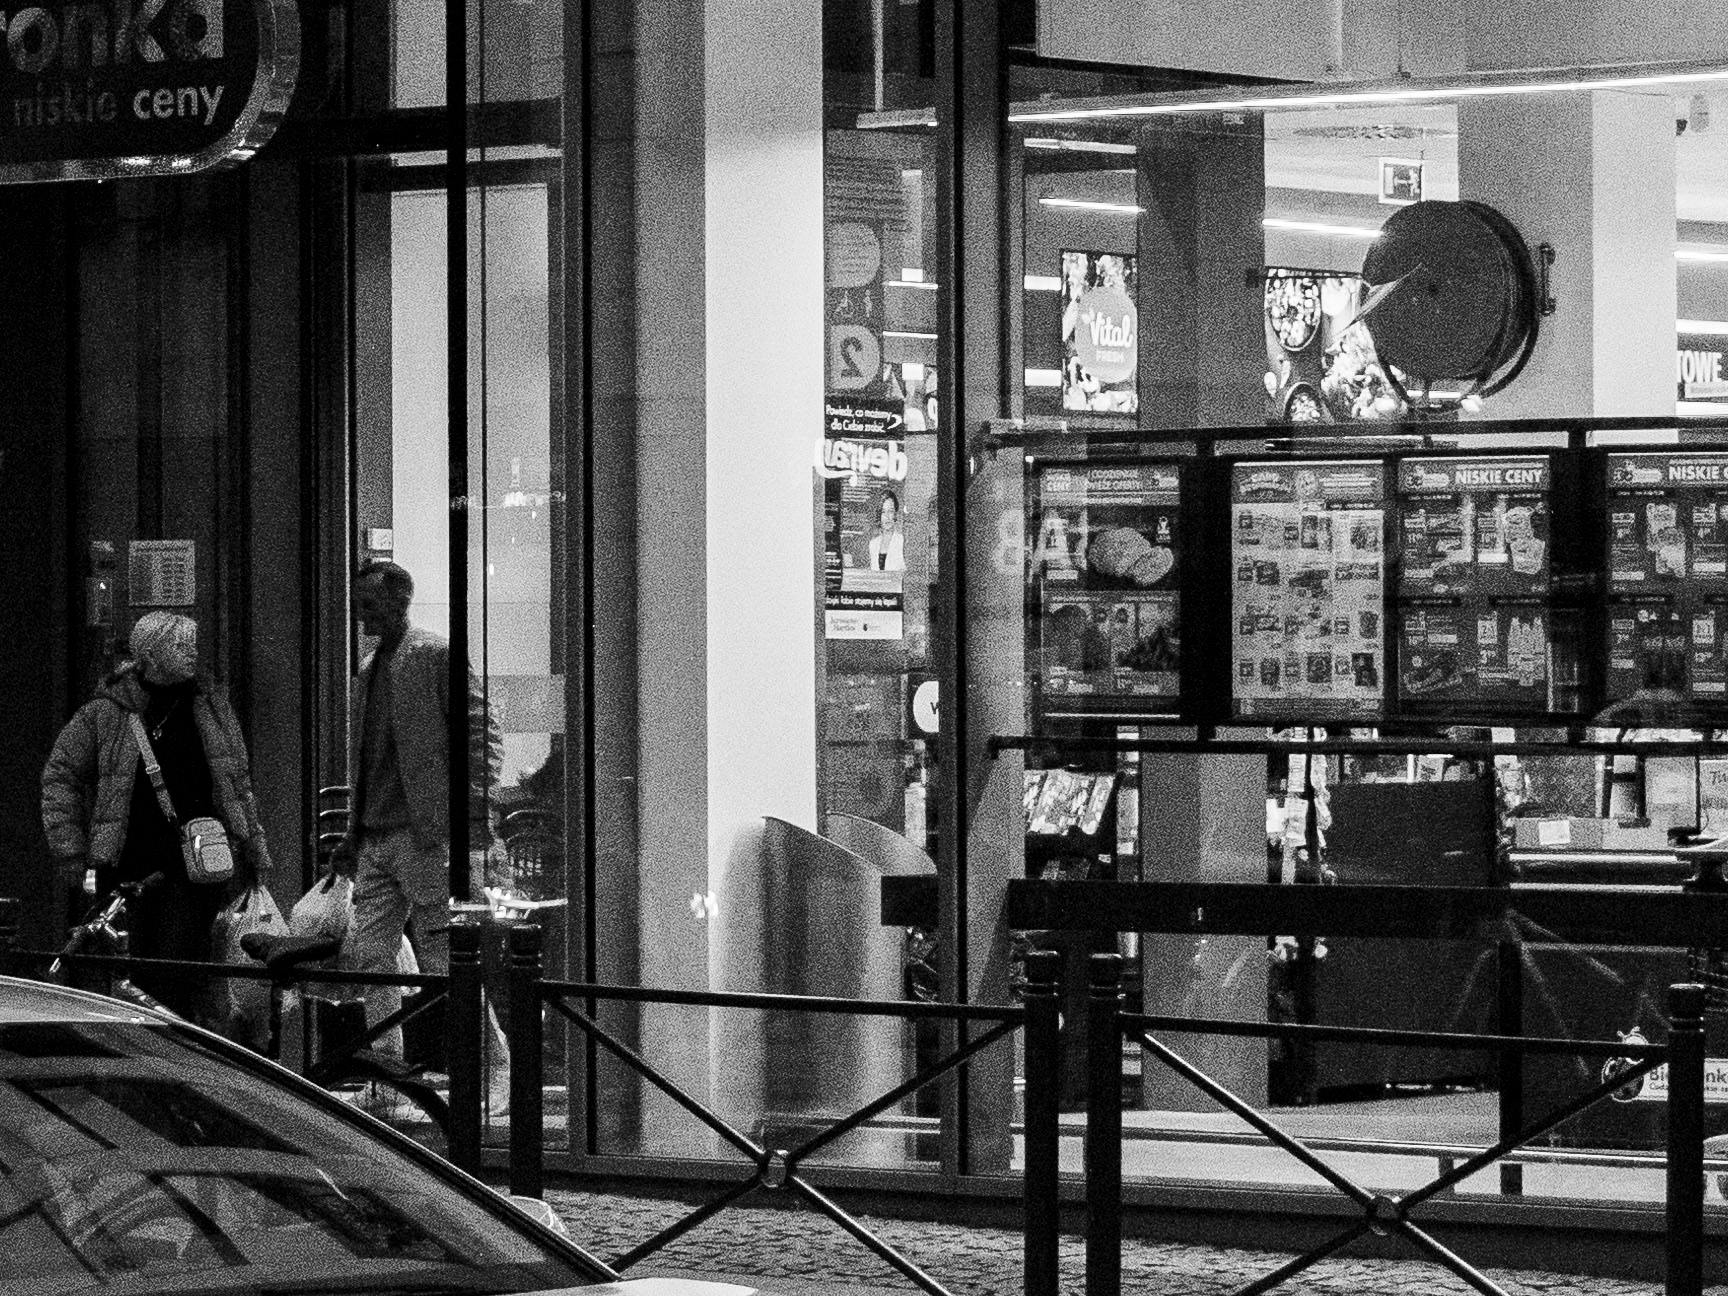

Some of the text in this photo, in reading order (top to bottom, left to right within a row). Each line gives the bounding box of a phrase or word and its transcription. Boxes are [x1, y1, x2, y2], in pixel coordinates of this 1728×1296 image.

[13, 79, 118, 128] niskie
[131, 84, 225, 127] ceny
[1090, 311, 1133, 348] Vital
[1455, 469, 1502, 485] NISKIE
[1505, 469, 1543, 484] CENY
[1669, 465, 1719, 481] NISKIE
